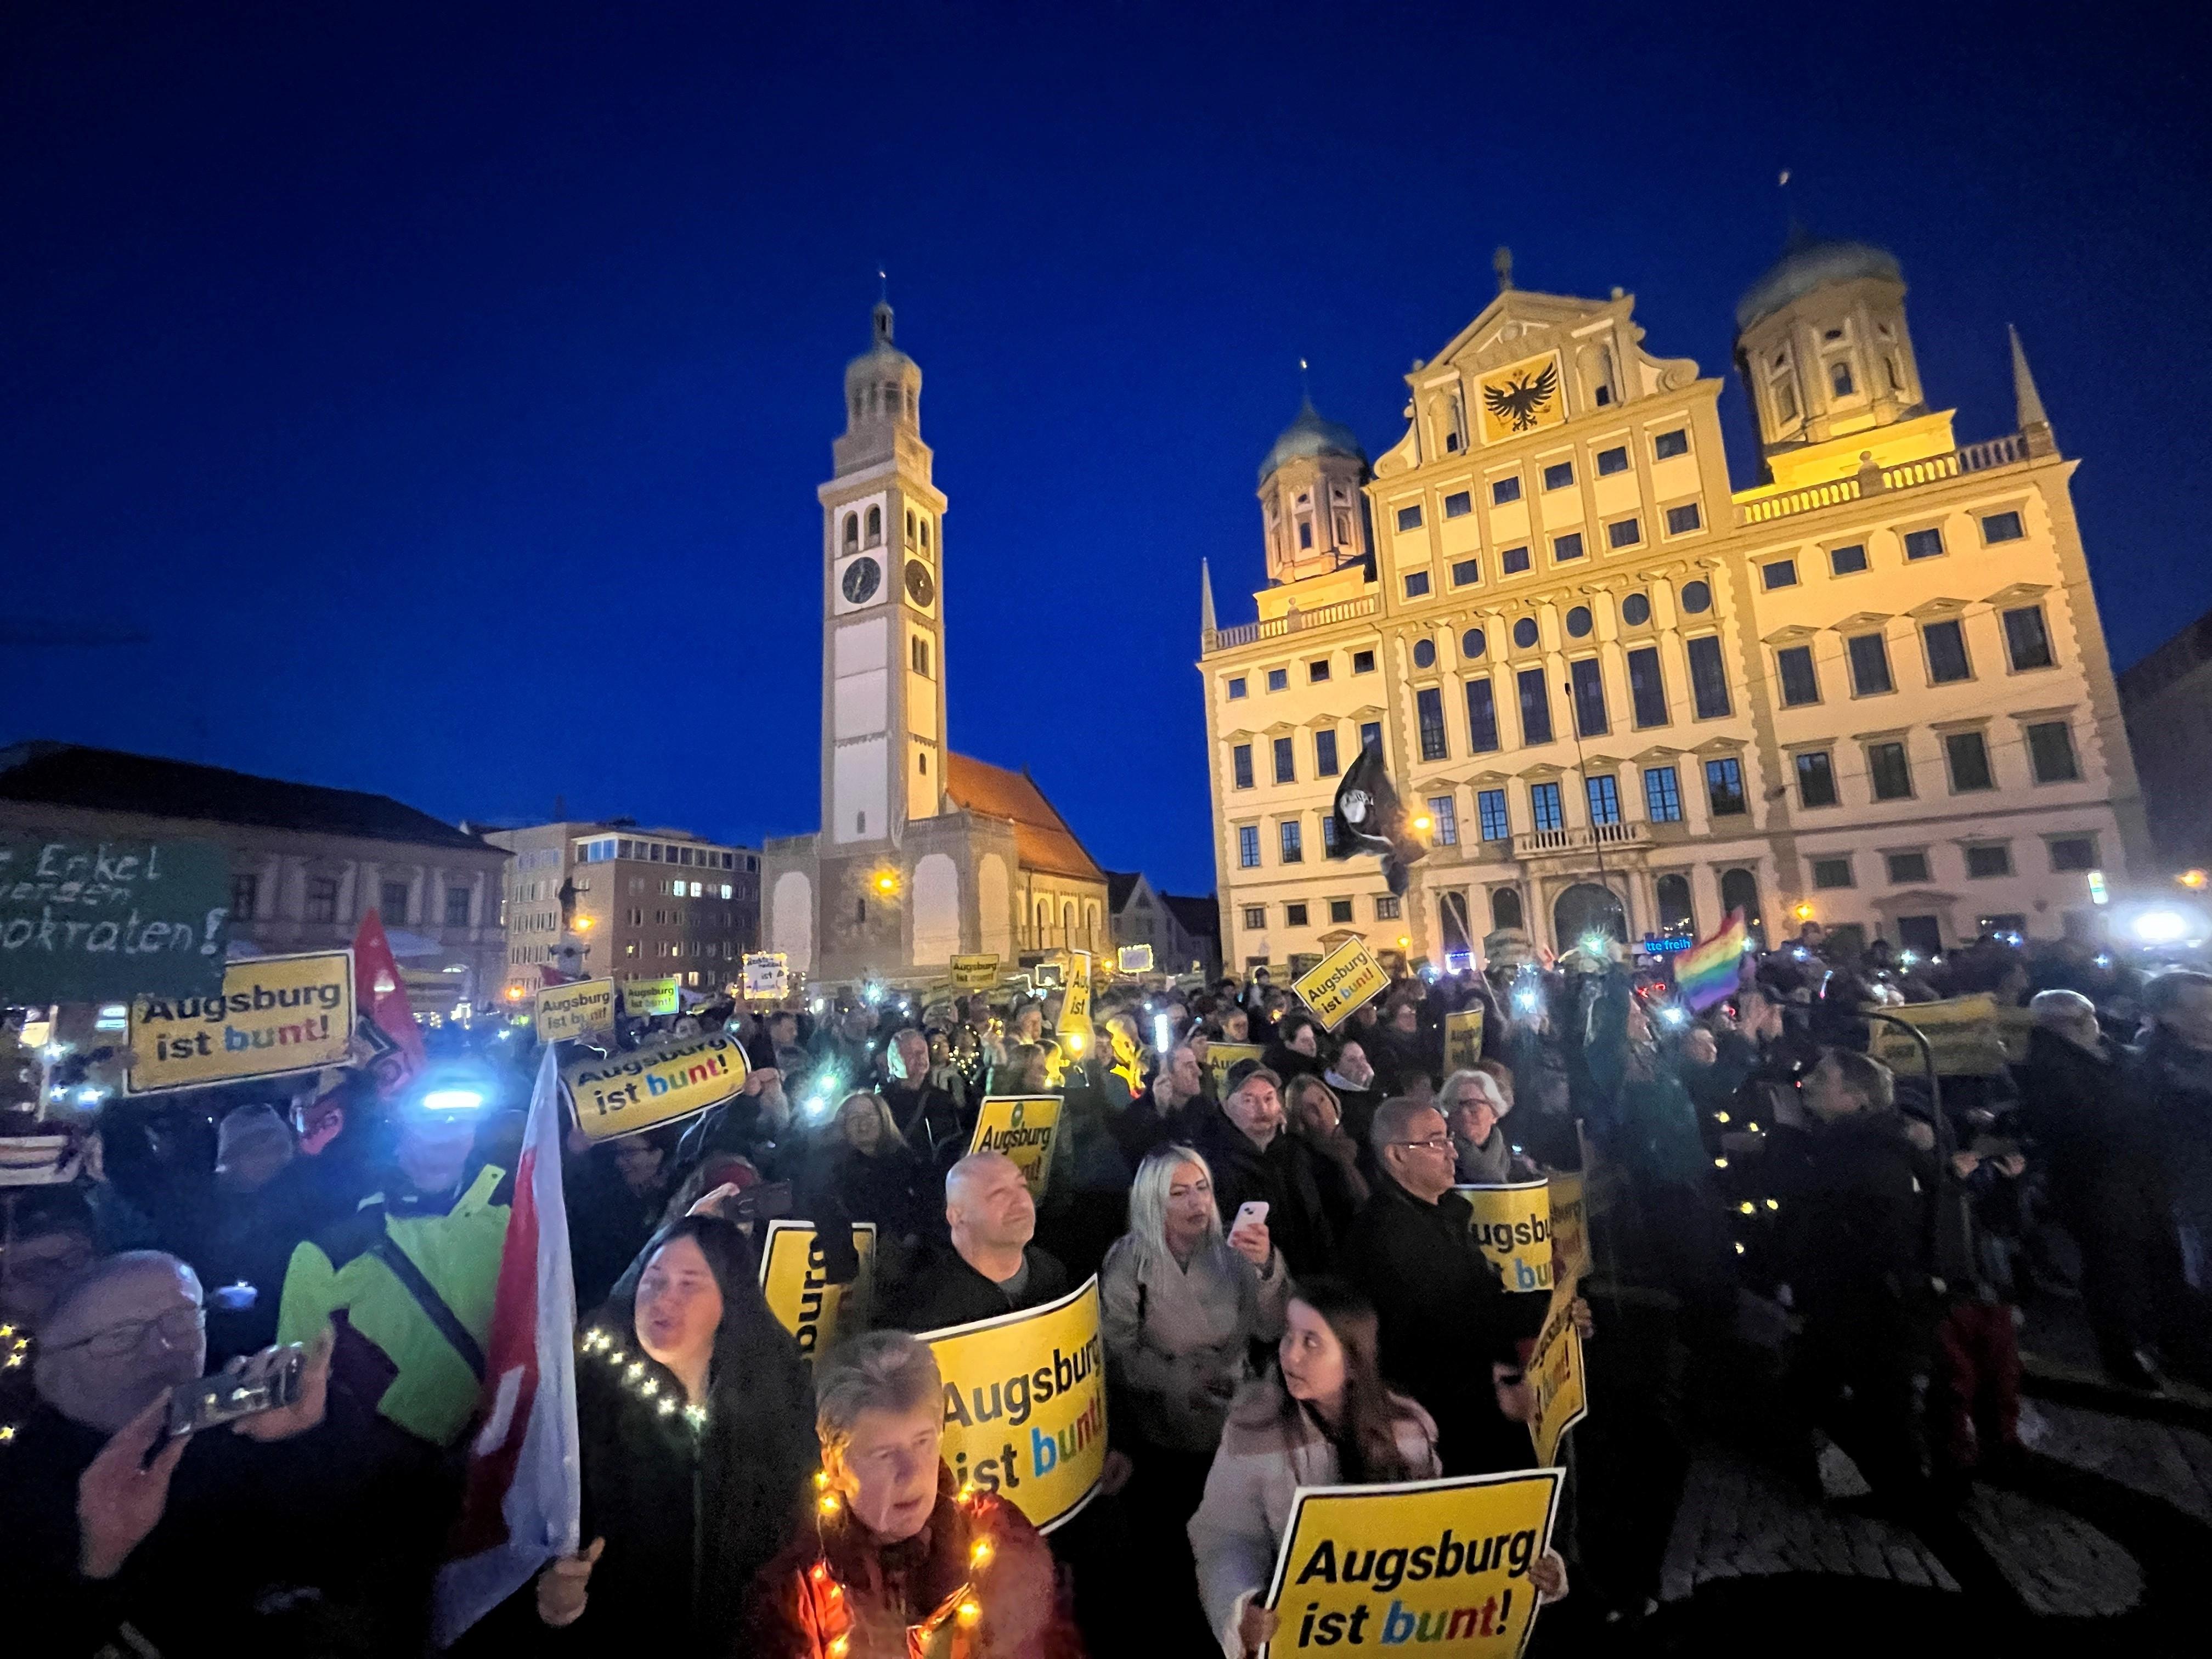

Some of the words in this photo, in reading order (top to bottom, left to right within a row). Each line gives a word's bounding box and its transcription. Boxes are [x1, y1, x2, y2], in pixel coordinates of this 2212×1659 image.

[1308, 952, 1368, 1002] Augsburg
[1321, 996, 1341, 1013] ist
[1340, 967, 1374, 1000] bunt!
[142, 984, 341, 1024] Augsburg
[543, 992, 610, 1013] Augsburg
[548, 1015, 567, 1029] ist
[1070, 996, 1085, 1014] ist
[157, 1030, 212, 1061] ist
[224, 1014, 329, 1052] bunt!
[578, 1039, 728, 1087] Augsburg
[594, 1082, 641, 1115] ist
[645, 1053, 729, 1097] bunt!
[978, 1121, 1052, 1155] Augsburg
[956, 1443, 1020, 1494] ist
[1296, 1529, 1537, 1593] Augsburg
[1298, 1602, 1369, 1647] ist
[1381, 1589, 1512, 1645] bunt!
